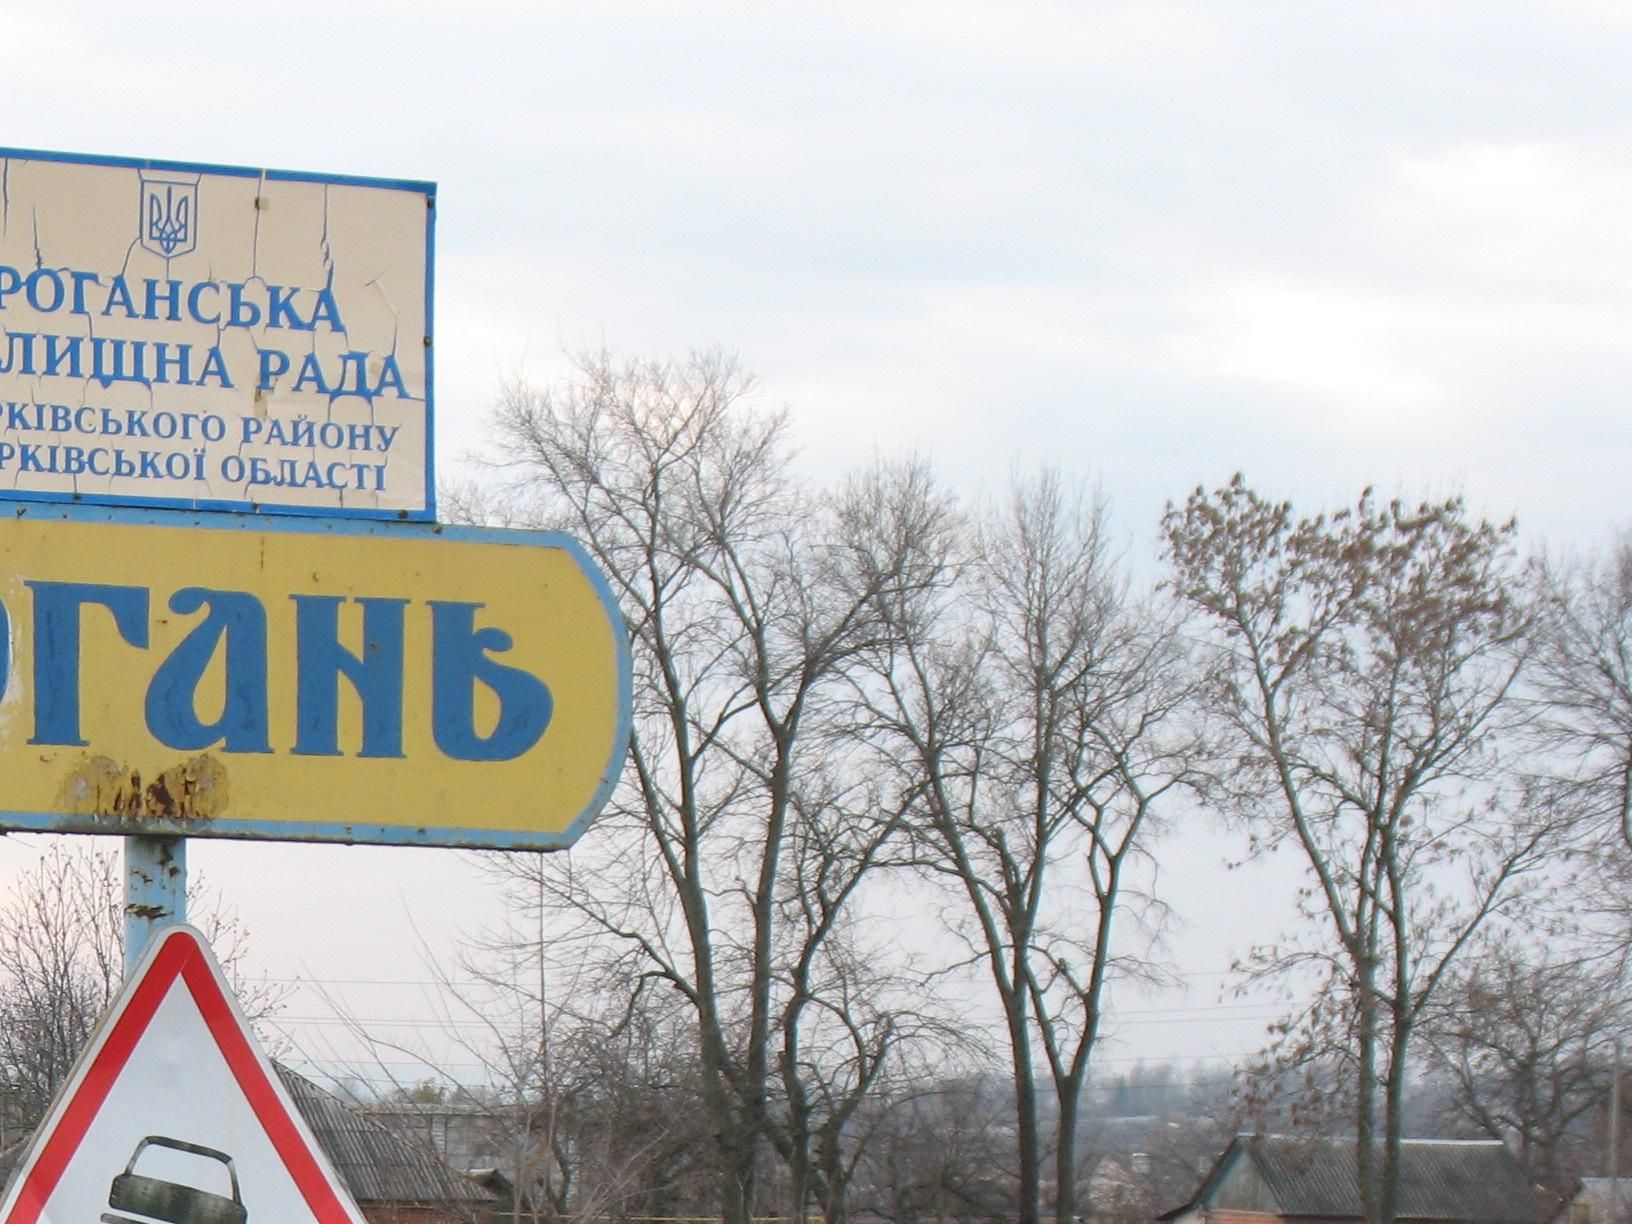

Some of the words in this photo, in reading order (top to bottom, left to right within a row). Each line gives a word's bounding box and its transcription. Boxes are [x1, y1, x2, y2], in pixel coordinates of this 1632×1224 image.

[258, 348, 410, 400] РАДА
[242, 413, 400, 452] РАЙОНУ
[221, 454, 387, 492] ОБЛАСТІ
